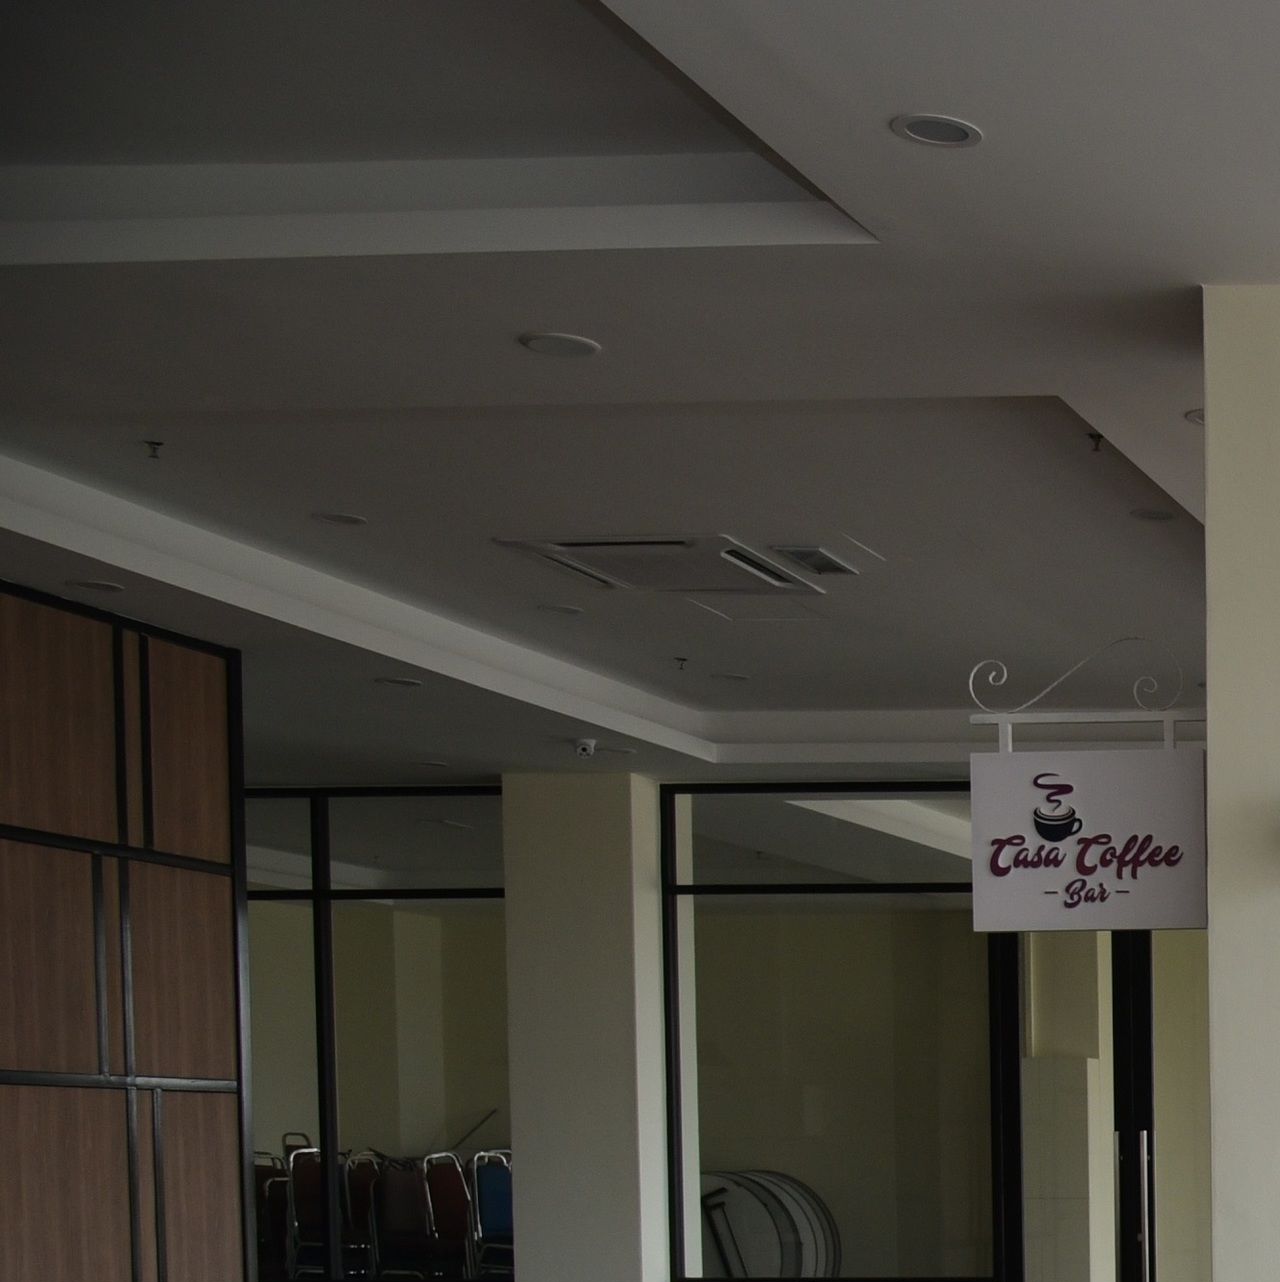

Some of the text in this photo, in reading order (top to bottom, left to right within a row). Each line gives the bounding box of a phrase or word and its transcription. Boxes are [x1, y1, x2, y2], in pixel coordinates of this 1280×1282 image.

[988, 833, 1184, 880] Casa Coffee
[1063, 878, 1111, 909] Bar
